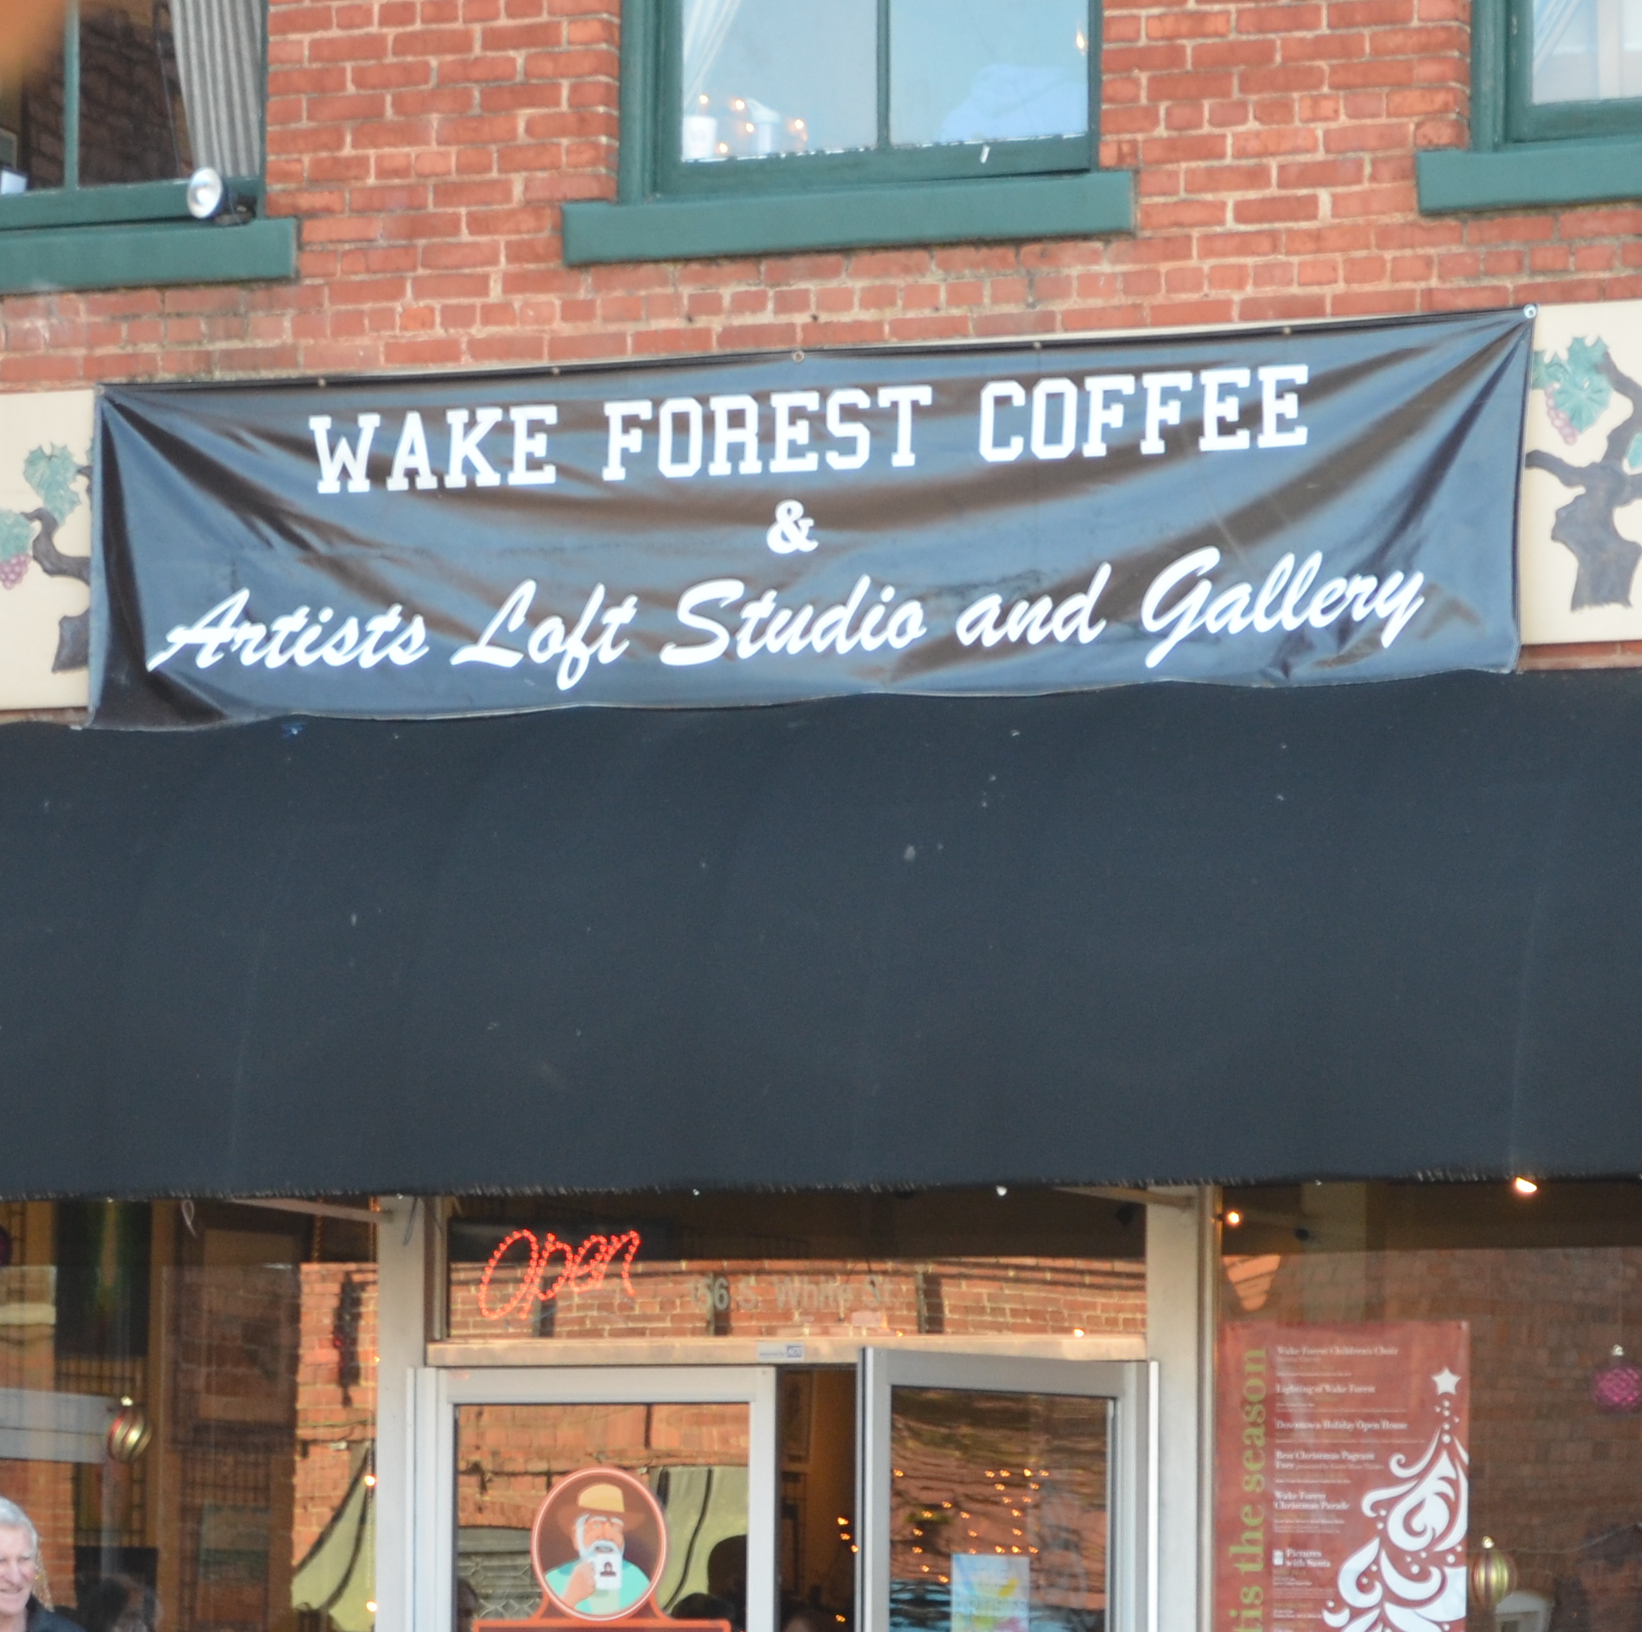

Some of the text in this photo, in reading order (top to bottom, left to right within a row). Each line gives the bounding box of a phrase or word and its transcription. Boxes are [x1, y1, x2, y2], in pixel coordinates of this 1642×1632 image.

[308, 363, 1311, 495] WAKE FOREST COFFEE
[765, 499, 820, 556] &
[146, 545, 1426, 692] Artists Loft Studio and Gallery
[477, 1227, 642, 1321] Open
[1241, 1348, 1267, 1494] season
[1229, 1503, 1265, 1575] the
